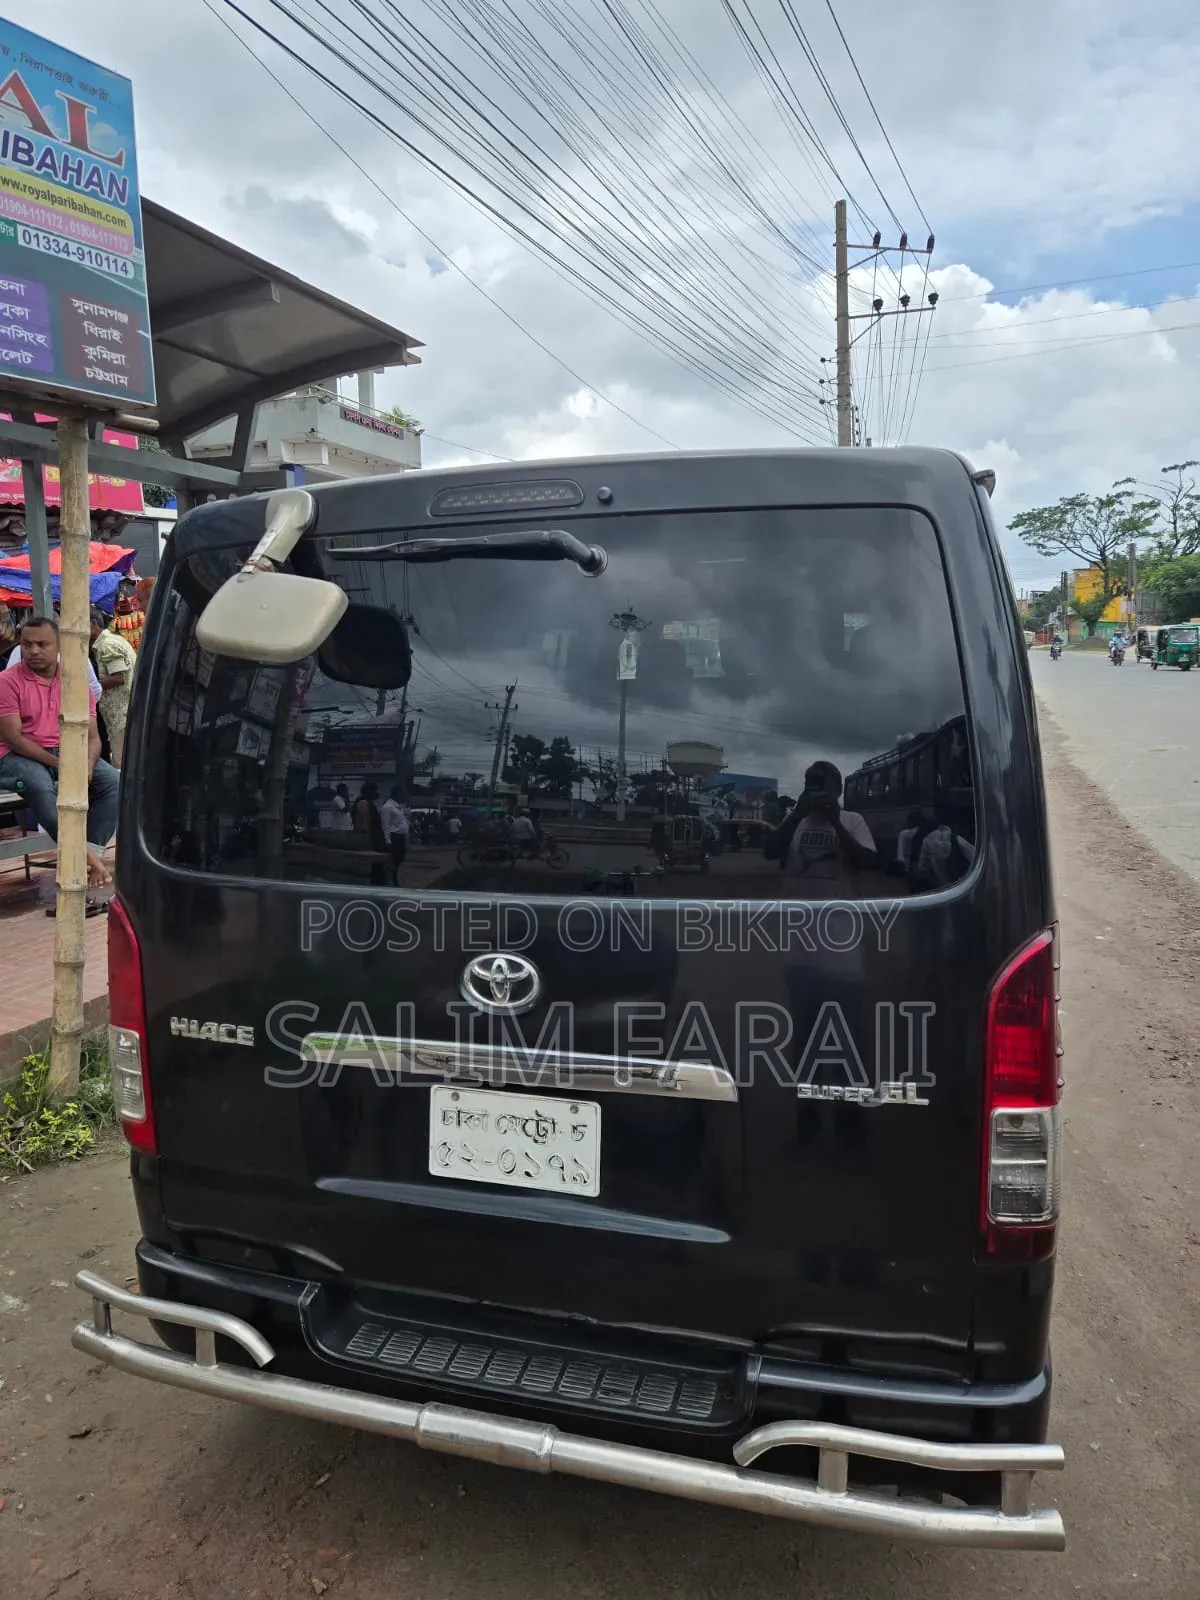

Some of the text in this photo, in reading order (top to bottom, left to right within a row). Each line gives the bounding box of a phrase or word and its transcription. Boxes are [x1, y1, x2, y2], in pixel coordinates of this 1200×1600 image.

[1, 129, 129, 204] IBAHAN
[22, 228, 129, 276] 01334-910114
[70, 297, 129, 324] সুনামগঞ্জ
[81, 344, 127, 366] কুমিল্লা
[83, 365, 129, 387] চট্টগ্রাম
[169, 1016, 255, 1047] HIACE
[797, 1081, 930, 1106] SUPER GL
[441, 1106, 489, 1132] ঢাকা
